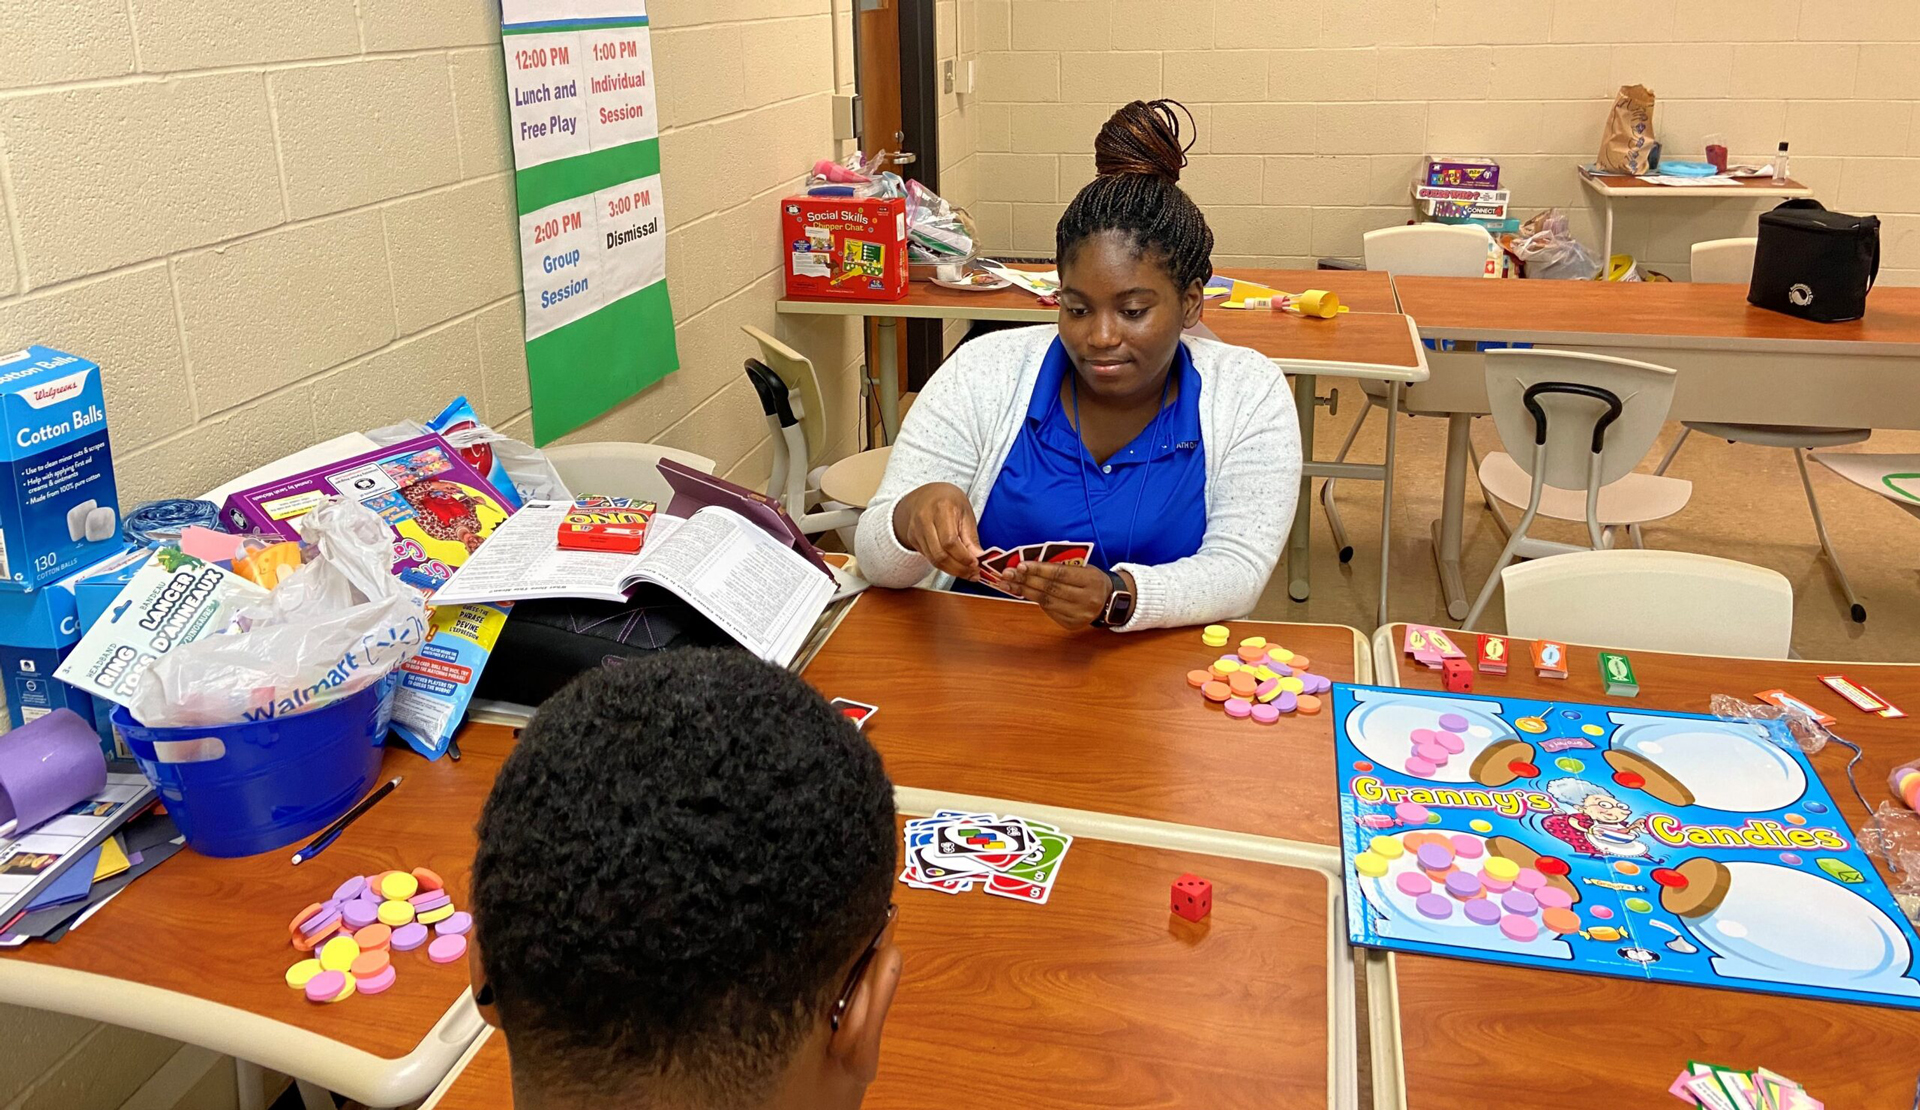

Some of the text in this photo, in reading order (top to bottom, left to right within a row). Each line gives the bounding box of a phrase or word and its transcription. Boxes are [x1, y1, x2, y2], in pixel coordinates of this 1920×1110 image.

[515, 46, 570, 70] 12:00 PM
[593, 40, 637, 61] 1:00 PM
[515, 80, 577, 106] Lunch and
[591, 71, 645, 95] Individual
[599, 103, 643, 125] Session
[521, 115, 577, 141] Free Play
[608, 190, 651, 218] 3:00 PM
[1467, 205, 1504, 217] CONNECT 4
[534, 212, 582, 244] 2:00 PM
[807, 210, 838, 222] Social
[841, 210, 869, 225] Skills
[844, 223, 864, 232] Chat
[606, 217, 658, 250] Dismissal
[543, 248, 580, 275] Group
[541, 277, 588, 309] Session
[0, 367, 43, 385] otton
[35, 356, 79, 370] Balls
[34, 381, 78, 401] Walgreens
[17, 404, 103, 448] Cotton Balls
[25, 467, 37, 476] Use
[44, 460, 58, 469] clean
[58, 454, 73, 463] minor
[73, 450, 84, 458] cuts
[27, 456, 93, 486] Help with applying first aid
[28, 484, 48, 494] creams
[29, 494, 46, 505] Made
[46, 489, 60, 498] from
[74, 480, 86, 489] pure
[85, 473, 101, 483] cotton
[568, 512, 649, 525] UNO
[34, 551, 57, 573] 130
[37, 557, 78, 581] COTTON BALLS
[139, 581, 167, 611] BANDEAU
[139, 571, 196, 631] LANCER
[150, 568, 224, 653] D'ANNEAUX
[458, 611, 486, 624] PHRASE
[455, 620, 479, 633] DEVINE
[86, 643, 117, 678] HEADBAND
[95, 644, 137, 689] RING
[115, 652, 157, 697] TOSS
[242, 651, 361, 722] Walmart
[428, 679, 447, 688] PLAYERS
[1353, 776, 1553, 816] Granny's
[1649, 816, 1846, 849] Candies
[1033, 870, 1046, 882] 6
[1029, 886, 1042, 899] 6
